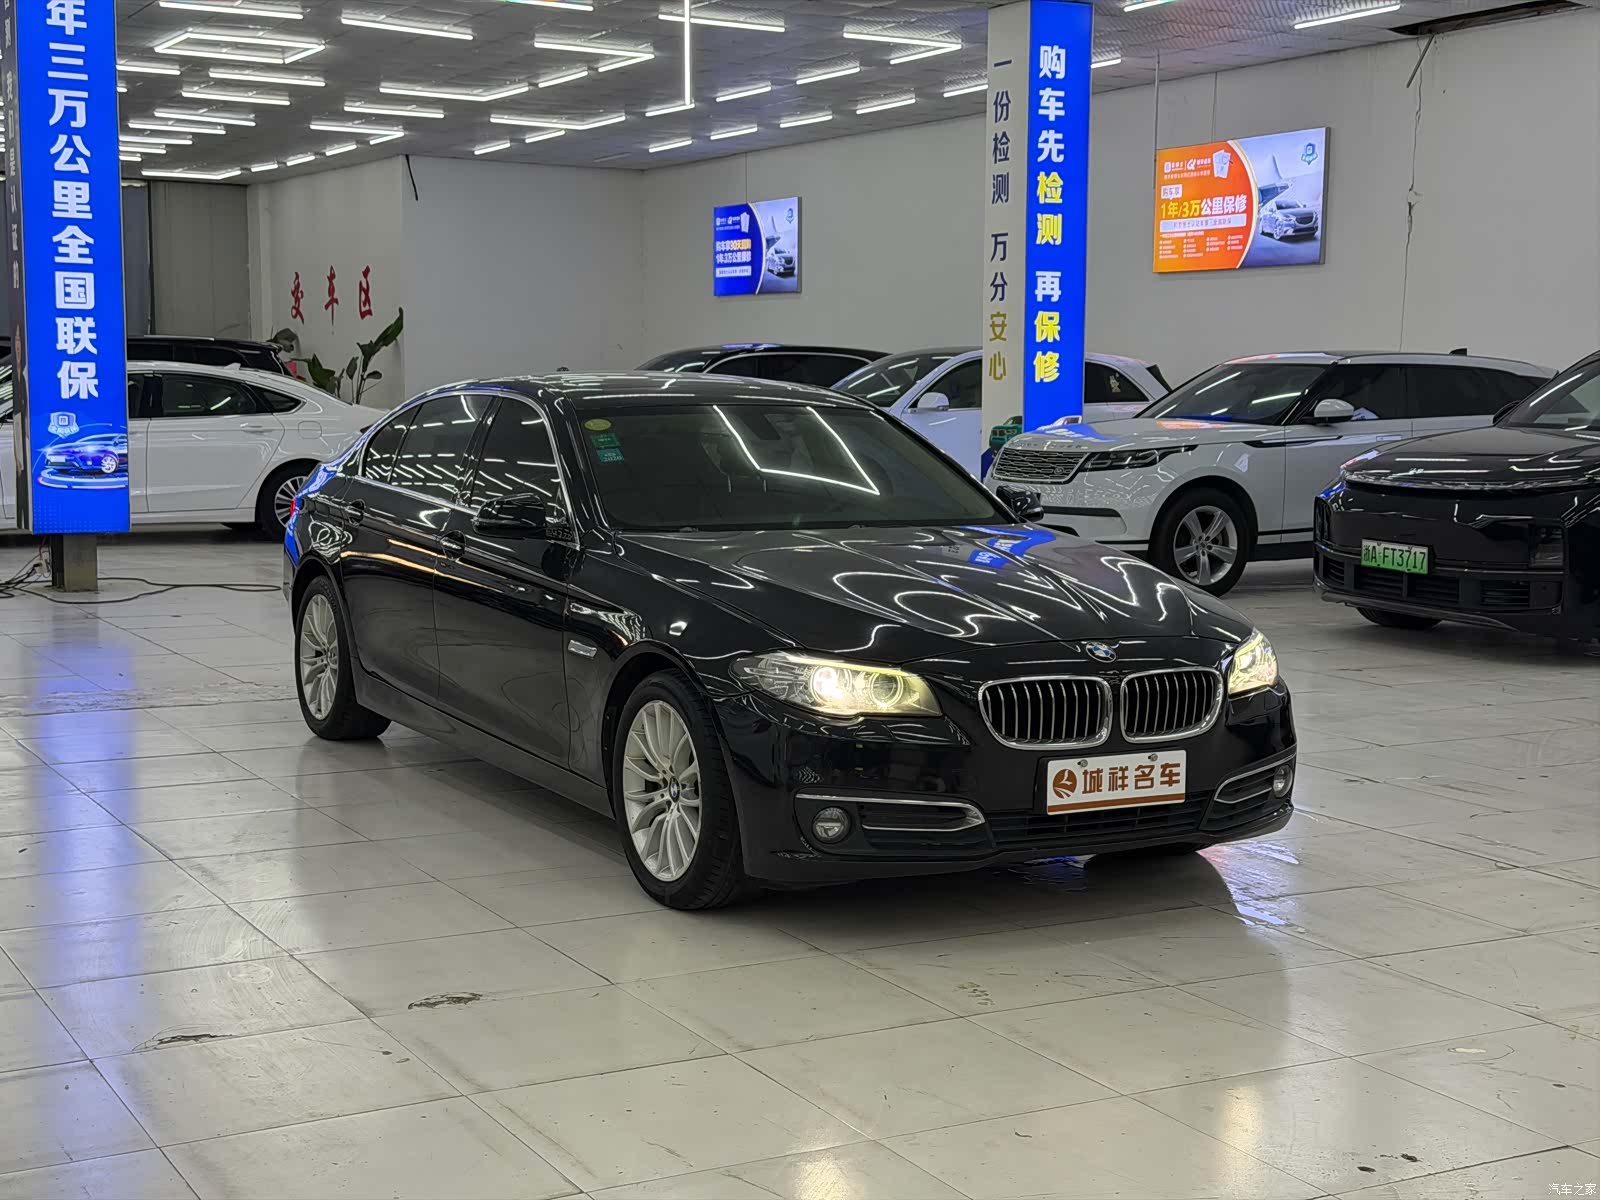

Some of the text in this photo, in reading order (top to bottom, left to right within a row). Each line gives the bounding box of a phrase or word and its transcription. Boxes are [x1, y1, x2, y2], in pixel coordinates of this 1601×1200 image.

[46, 0, 98, 399] 年三万公里全国联保
[989, 59, 1012, 381] 一份检测 万分安心
[1033, 45, 1066, 383] 购车先检测 再保修
[1161, 194, 1247, 219] 1年/3万公里保修
[1082, 762, 1181, 794] 城祥名车
